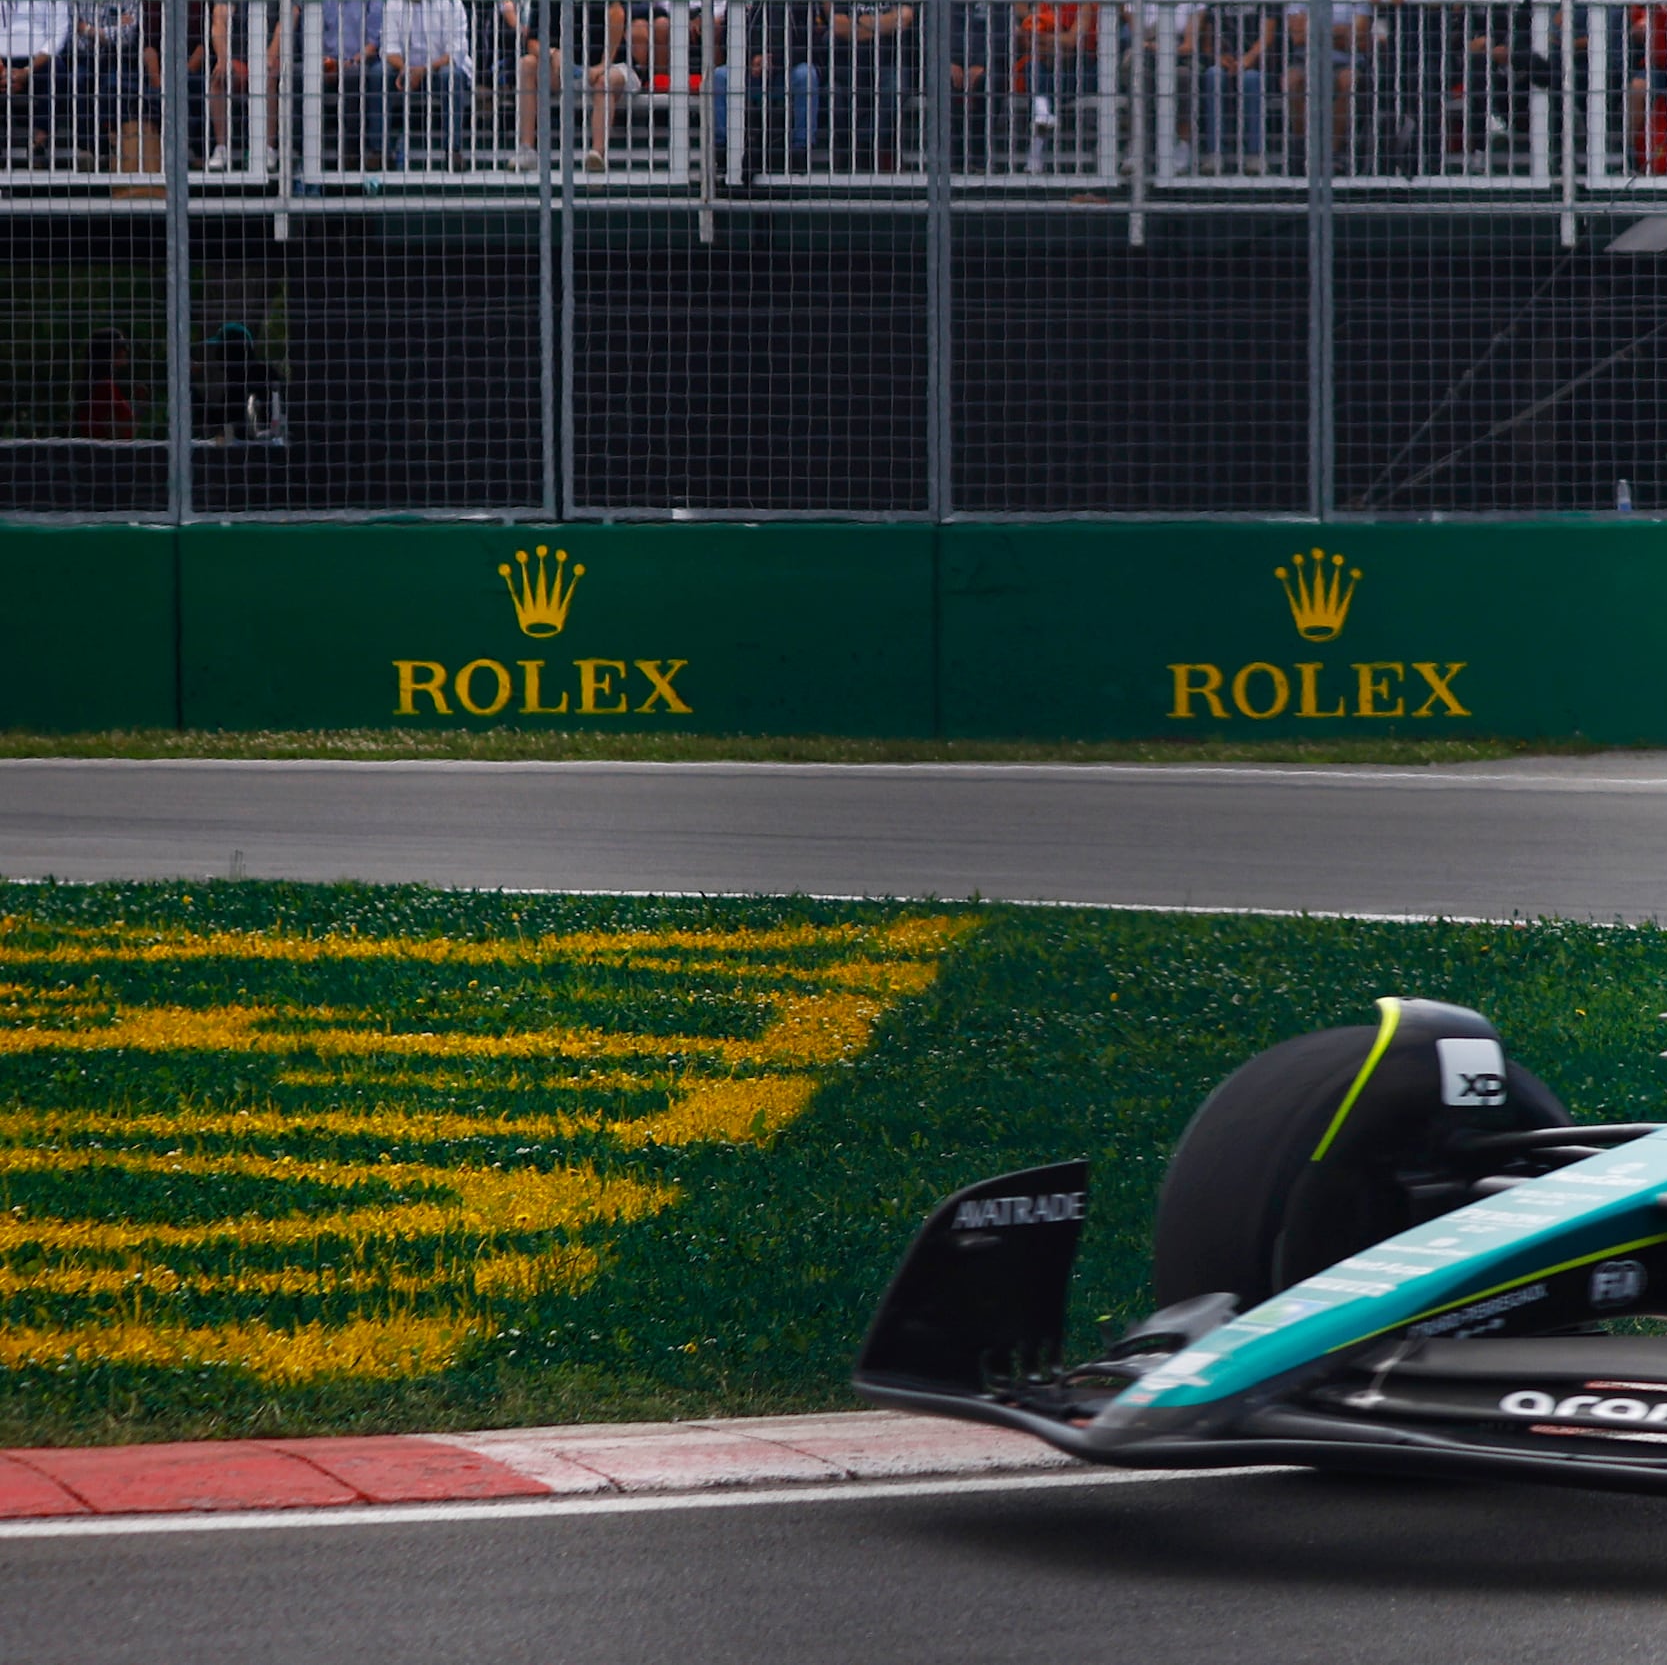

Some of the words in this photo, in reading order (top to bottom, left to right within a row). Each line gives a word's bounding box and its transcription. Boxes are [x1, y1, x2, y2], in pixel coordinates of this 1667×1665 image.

[392, 659, 693, 716] ROLEX
[1166, 660, 1473, 720] ROLEX
[951, 1192, 1085, 1229] AVATRADE
